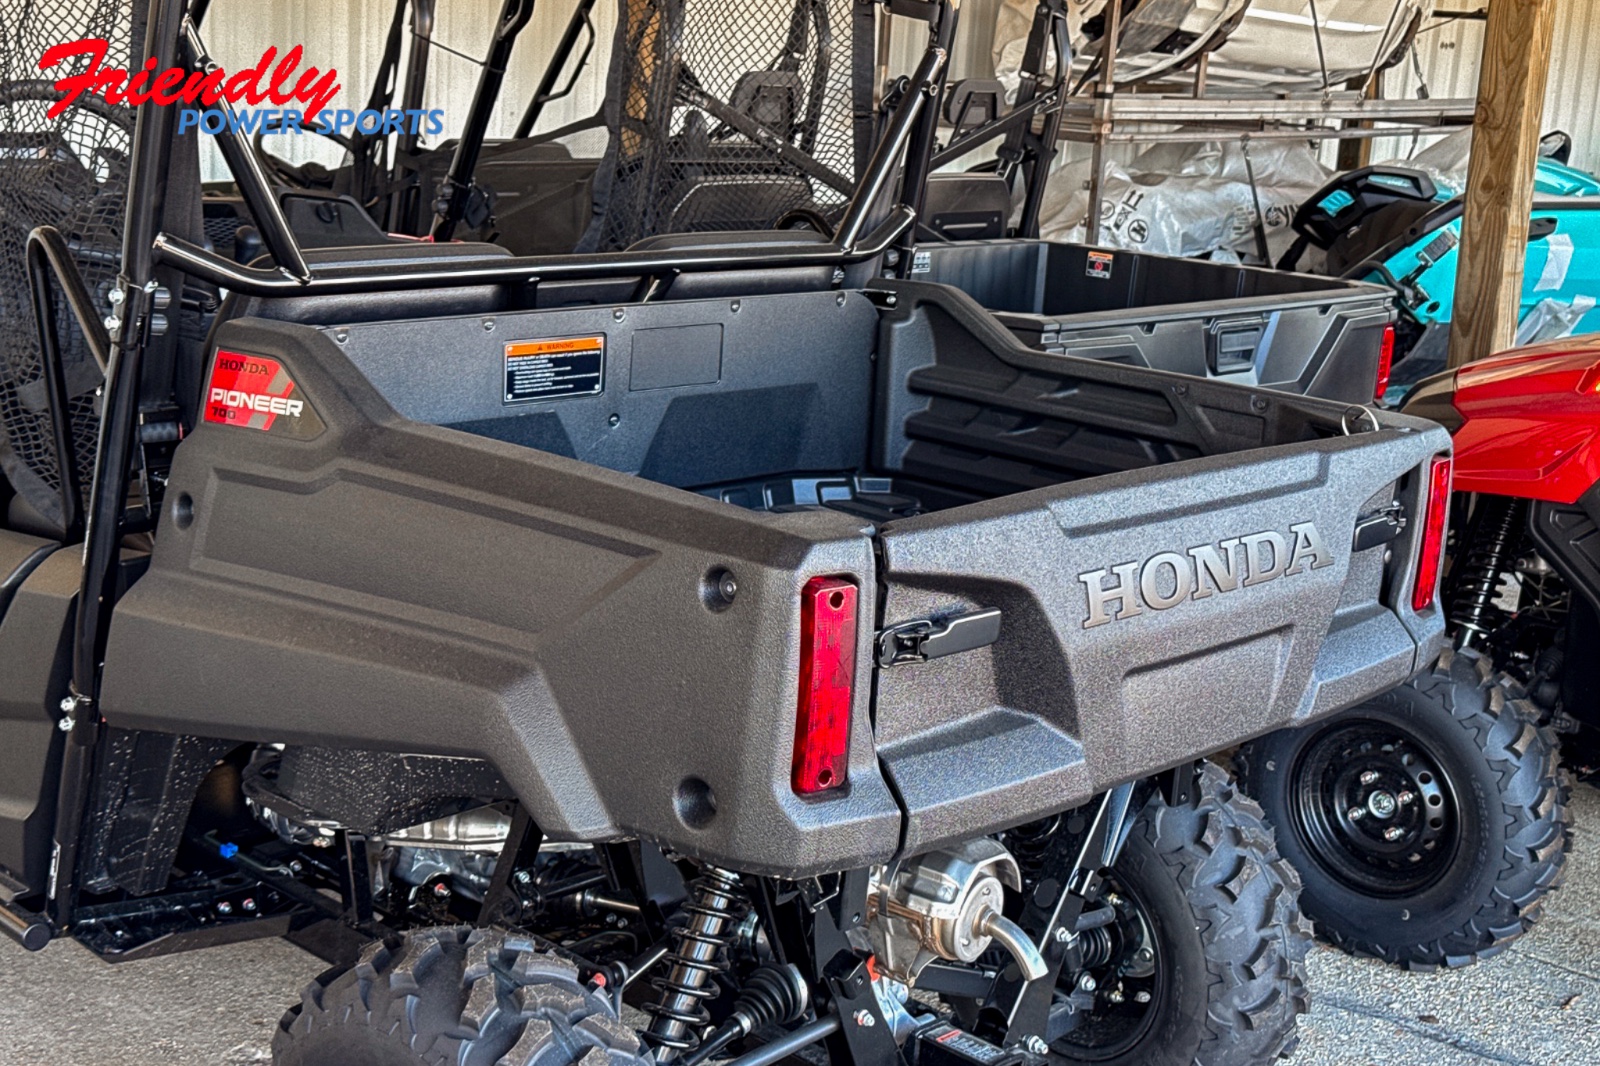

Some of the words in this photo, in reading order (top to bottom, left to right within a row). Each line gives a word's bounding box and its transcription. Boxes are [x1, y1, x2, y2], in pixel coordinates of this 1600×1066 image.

[546, 342, 574, 350] WARNING
[219, 358, 269, 375] HONDA
[210, 387, 304, 417] PIONEER
[211, 406, 236, 420] 700
[1078, 520, 1335, 630] HONDA
